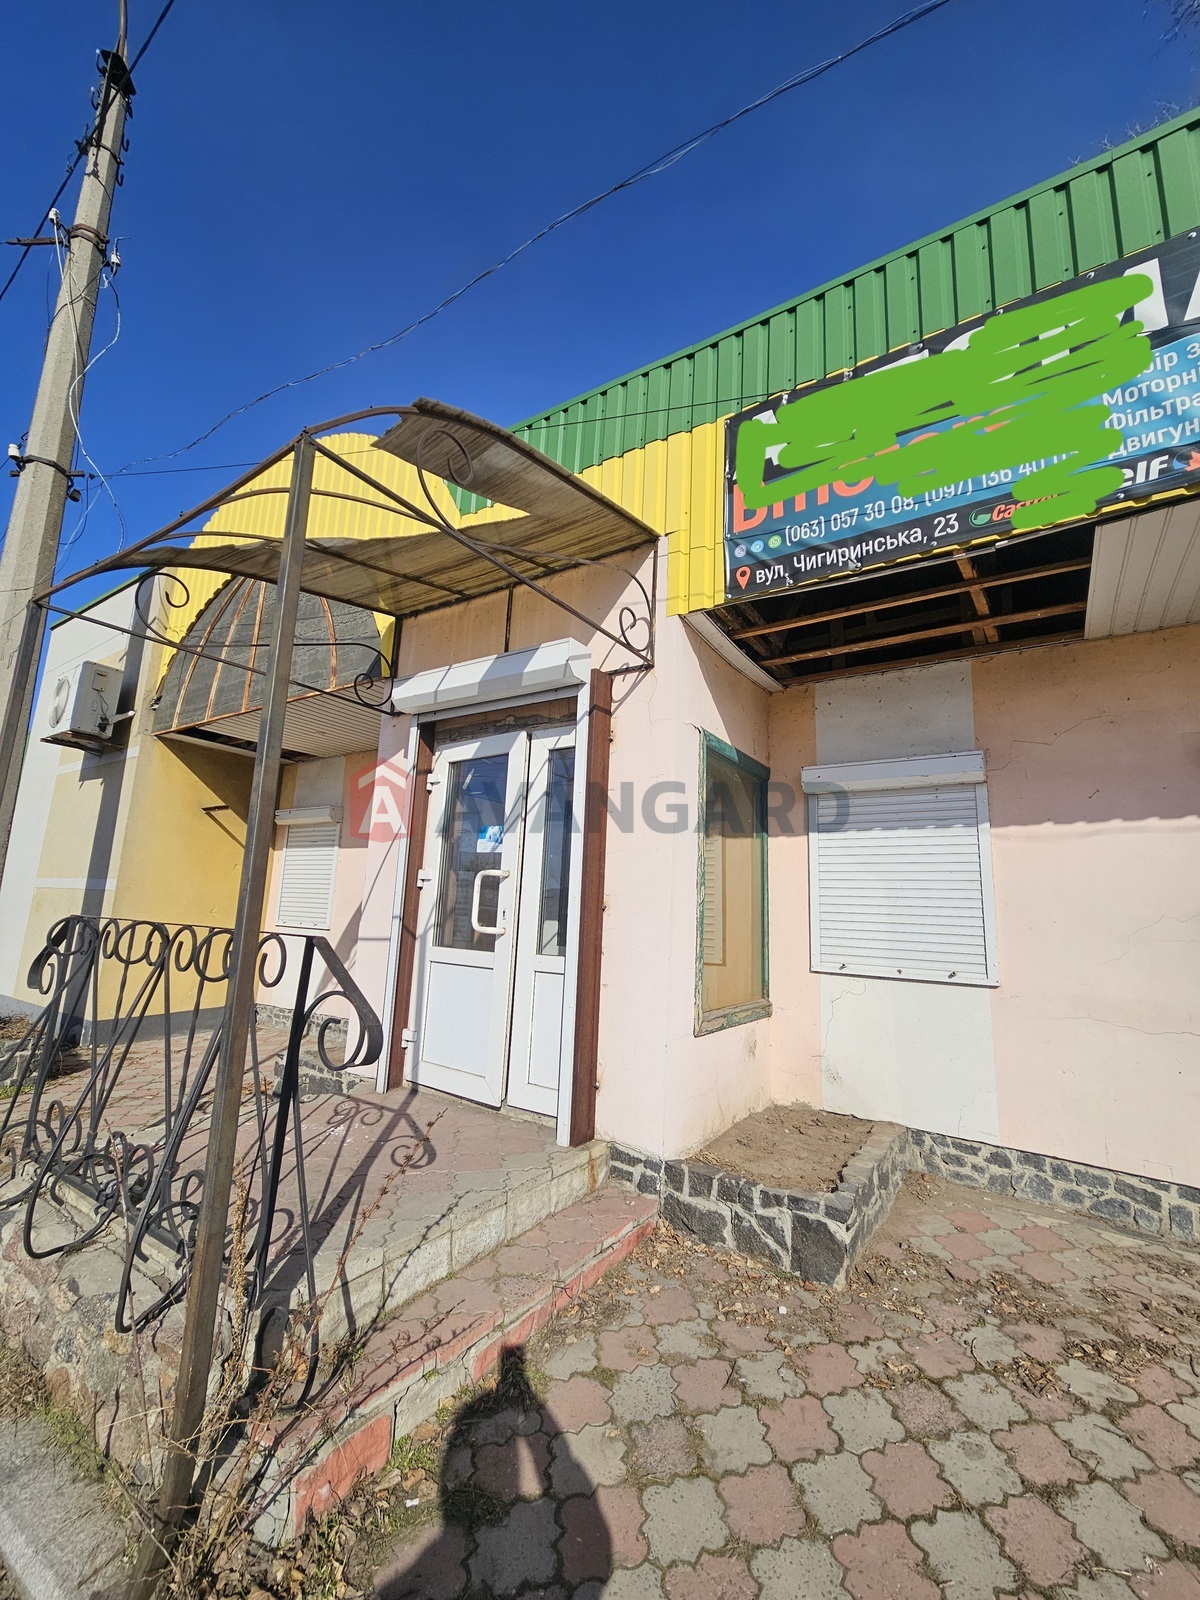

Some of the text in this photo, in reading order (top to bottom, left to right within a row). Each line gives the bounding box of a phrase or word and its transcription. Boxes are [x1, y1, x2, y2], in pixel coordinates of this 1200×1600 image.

[755, 512, 959, 586] вул. Чигиринська, 23
[785, 516, 825, 547] (063)
[831, 507, 859, 532] 057
[864, 500, 886, 522] 30
